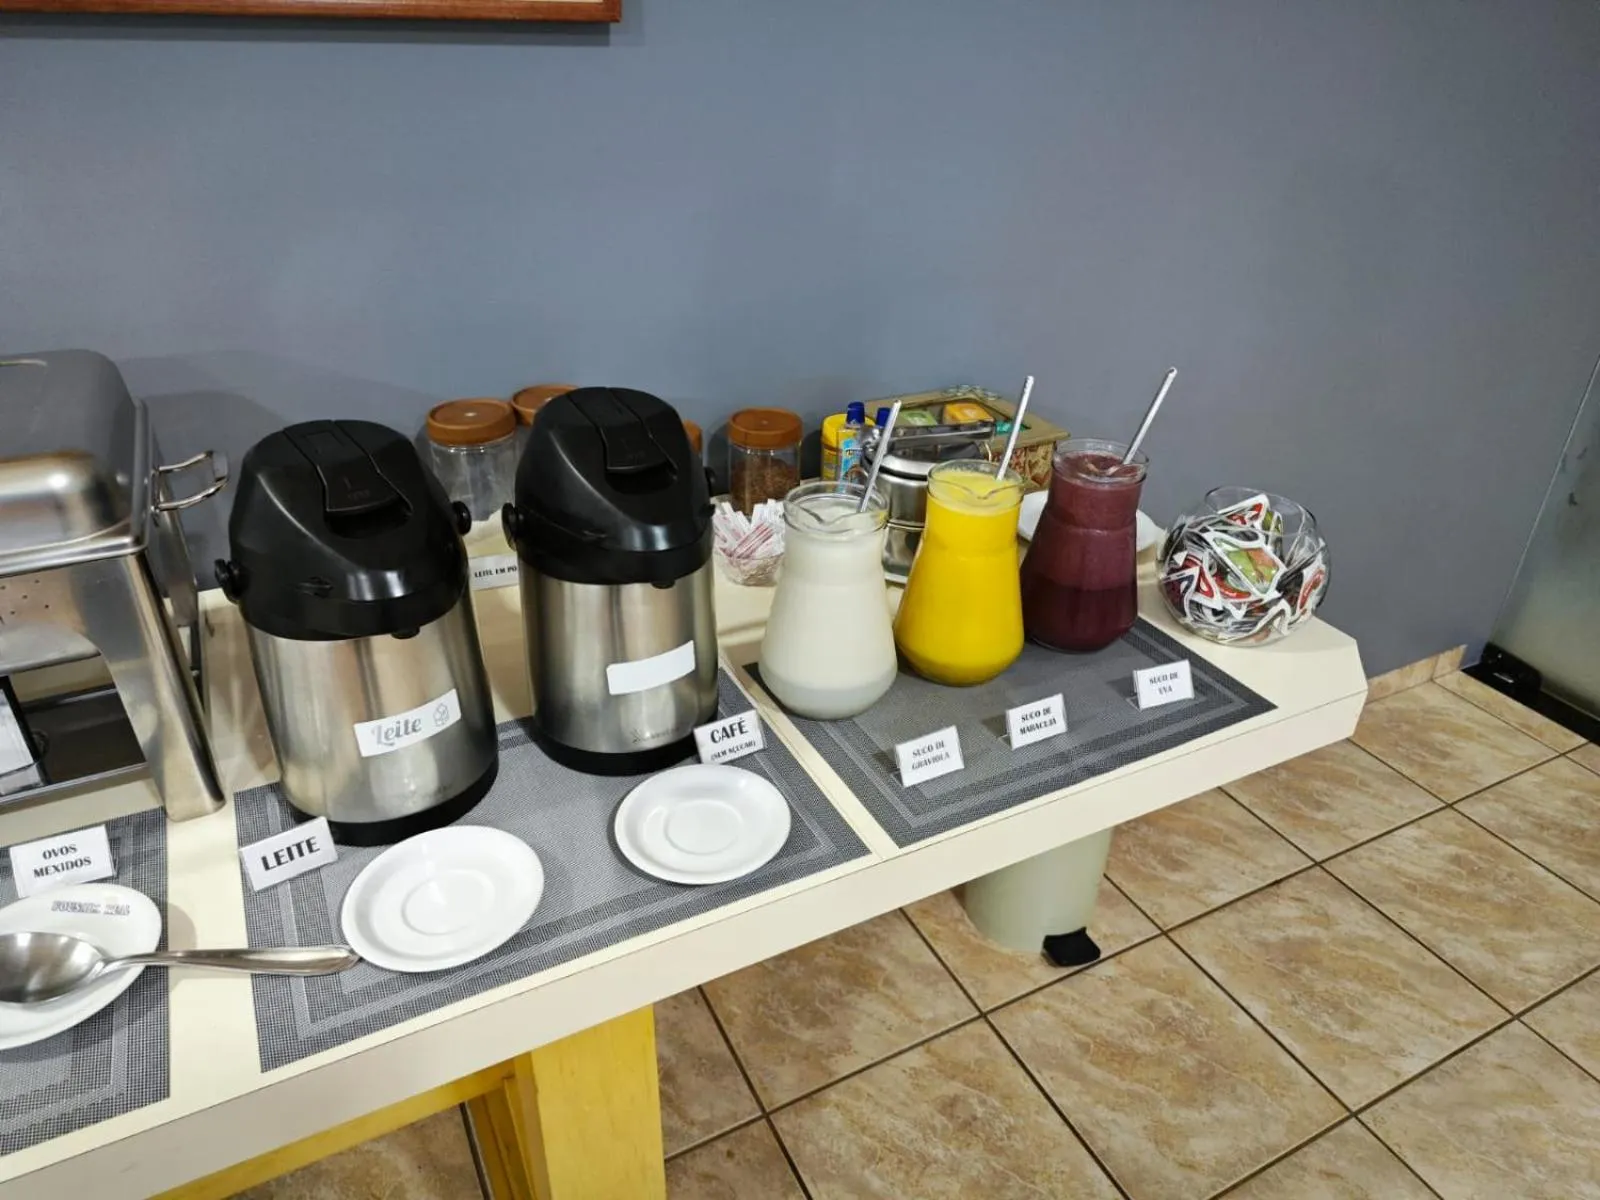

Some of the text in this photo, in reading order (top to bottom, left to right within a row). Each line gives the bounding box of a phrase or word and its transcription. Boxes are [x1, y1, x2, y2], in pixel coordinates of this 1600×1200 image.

[474, 568, 494, 578] LEITE
[1149, 674, 1168, 685] SUCO
[1158, 685, 1173, 695] UVA
[1021, 706, 1051, 723] SUCO DE
[371, 717, 422, 746] Leite
[710, 716, 749, 744] CAFÉ
[912, 743, 934, 757] SUCO
[911, 751, 950, 770] GRAVIOLA
[42, 844, 78, 860] OVOS
[260, 836, 321, 871] LEITE
[33, 856, 92, 878] MEXIDOS
